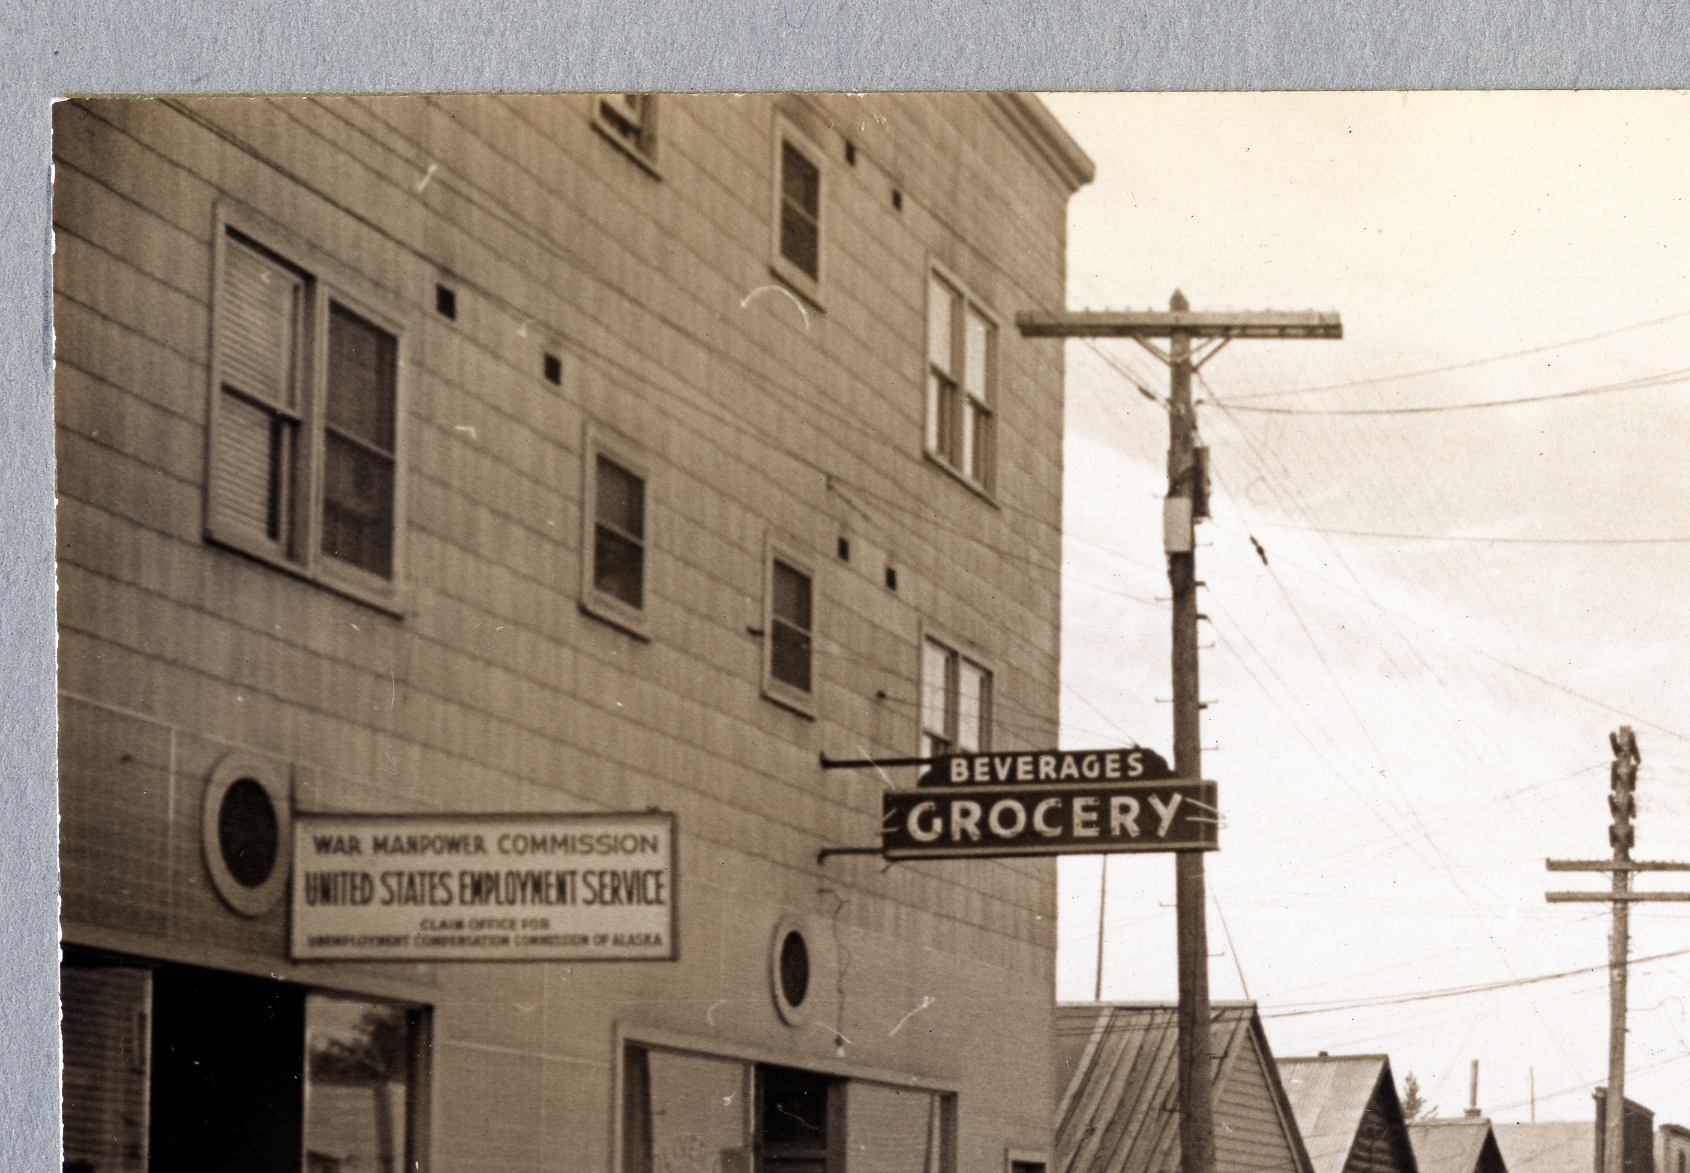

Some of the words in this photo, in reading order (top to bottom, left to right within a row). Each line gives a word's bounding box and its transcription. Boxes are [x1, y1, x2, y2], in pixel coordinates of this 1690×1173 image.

[950, 753, 1144, 783] BEVERAGES
[907, 793, 1182, 842] GROCERY
[312, 834, 362, 856] WAR
[372, 834, 486, 856] MANPOWER
[498, 832, 659, 855] COMMISSION
[304, 870, 374, 907] UNITED
[380, 869, 453, 907] STATES
[458, 869, 578, 907] EMPLOYMENT
[582, 868, 665, 907] SERVICE
[419, 918, 464, 931] CLAIM
[468, 918, 517, 931] OFFICE
[521, 918, 550, 931] FOR
[307, 934, 410, 948] UNEMPLOYMENT
[414, 934, 511, 948] COMPENSATION
[514, 933, 589, 947] COMMISSION
[593, 933, 607, 947] OF
[612, 933, 662, 947] ALASKA
